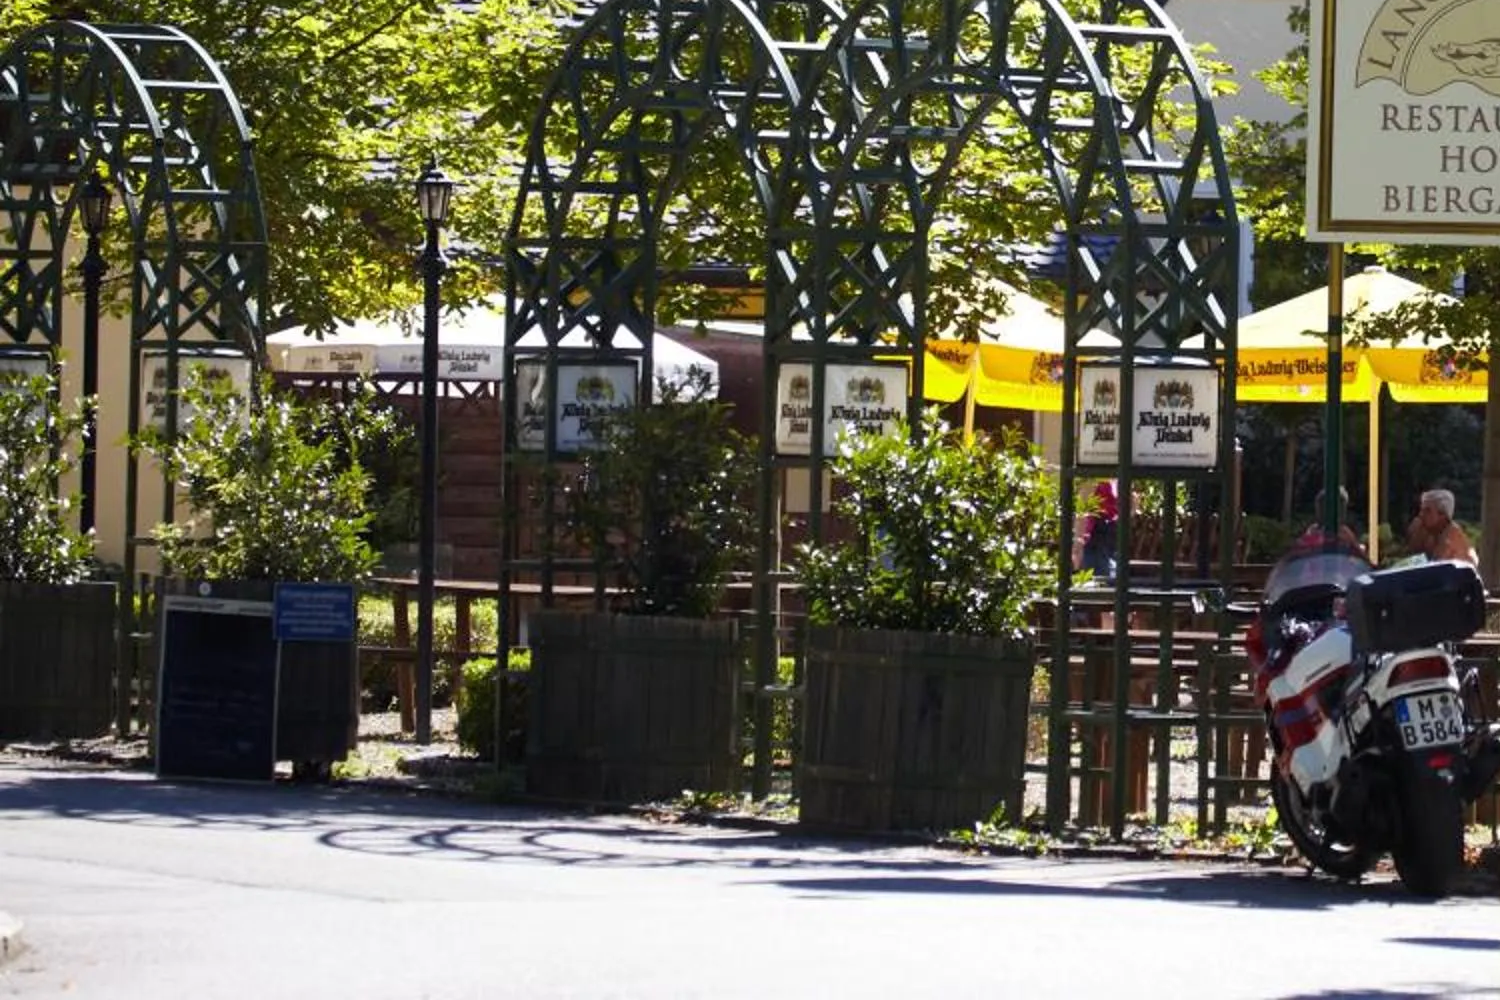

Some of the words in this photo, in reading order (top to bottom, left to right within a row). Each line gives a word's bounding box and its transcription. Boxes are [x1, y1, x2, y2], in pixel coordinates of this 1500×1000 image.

[1169, 411, 1211, 432] Ludwig
[1417, 698, 1436, 719] M
[1403, 725, 1418, 746] B
[1420, 719, 1461, 743] 584
